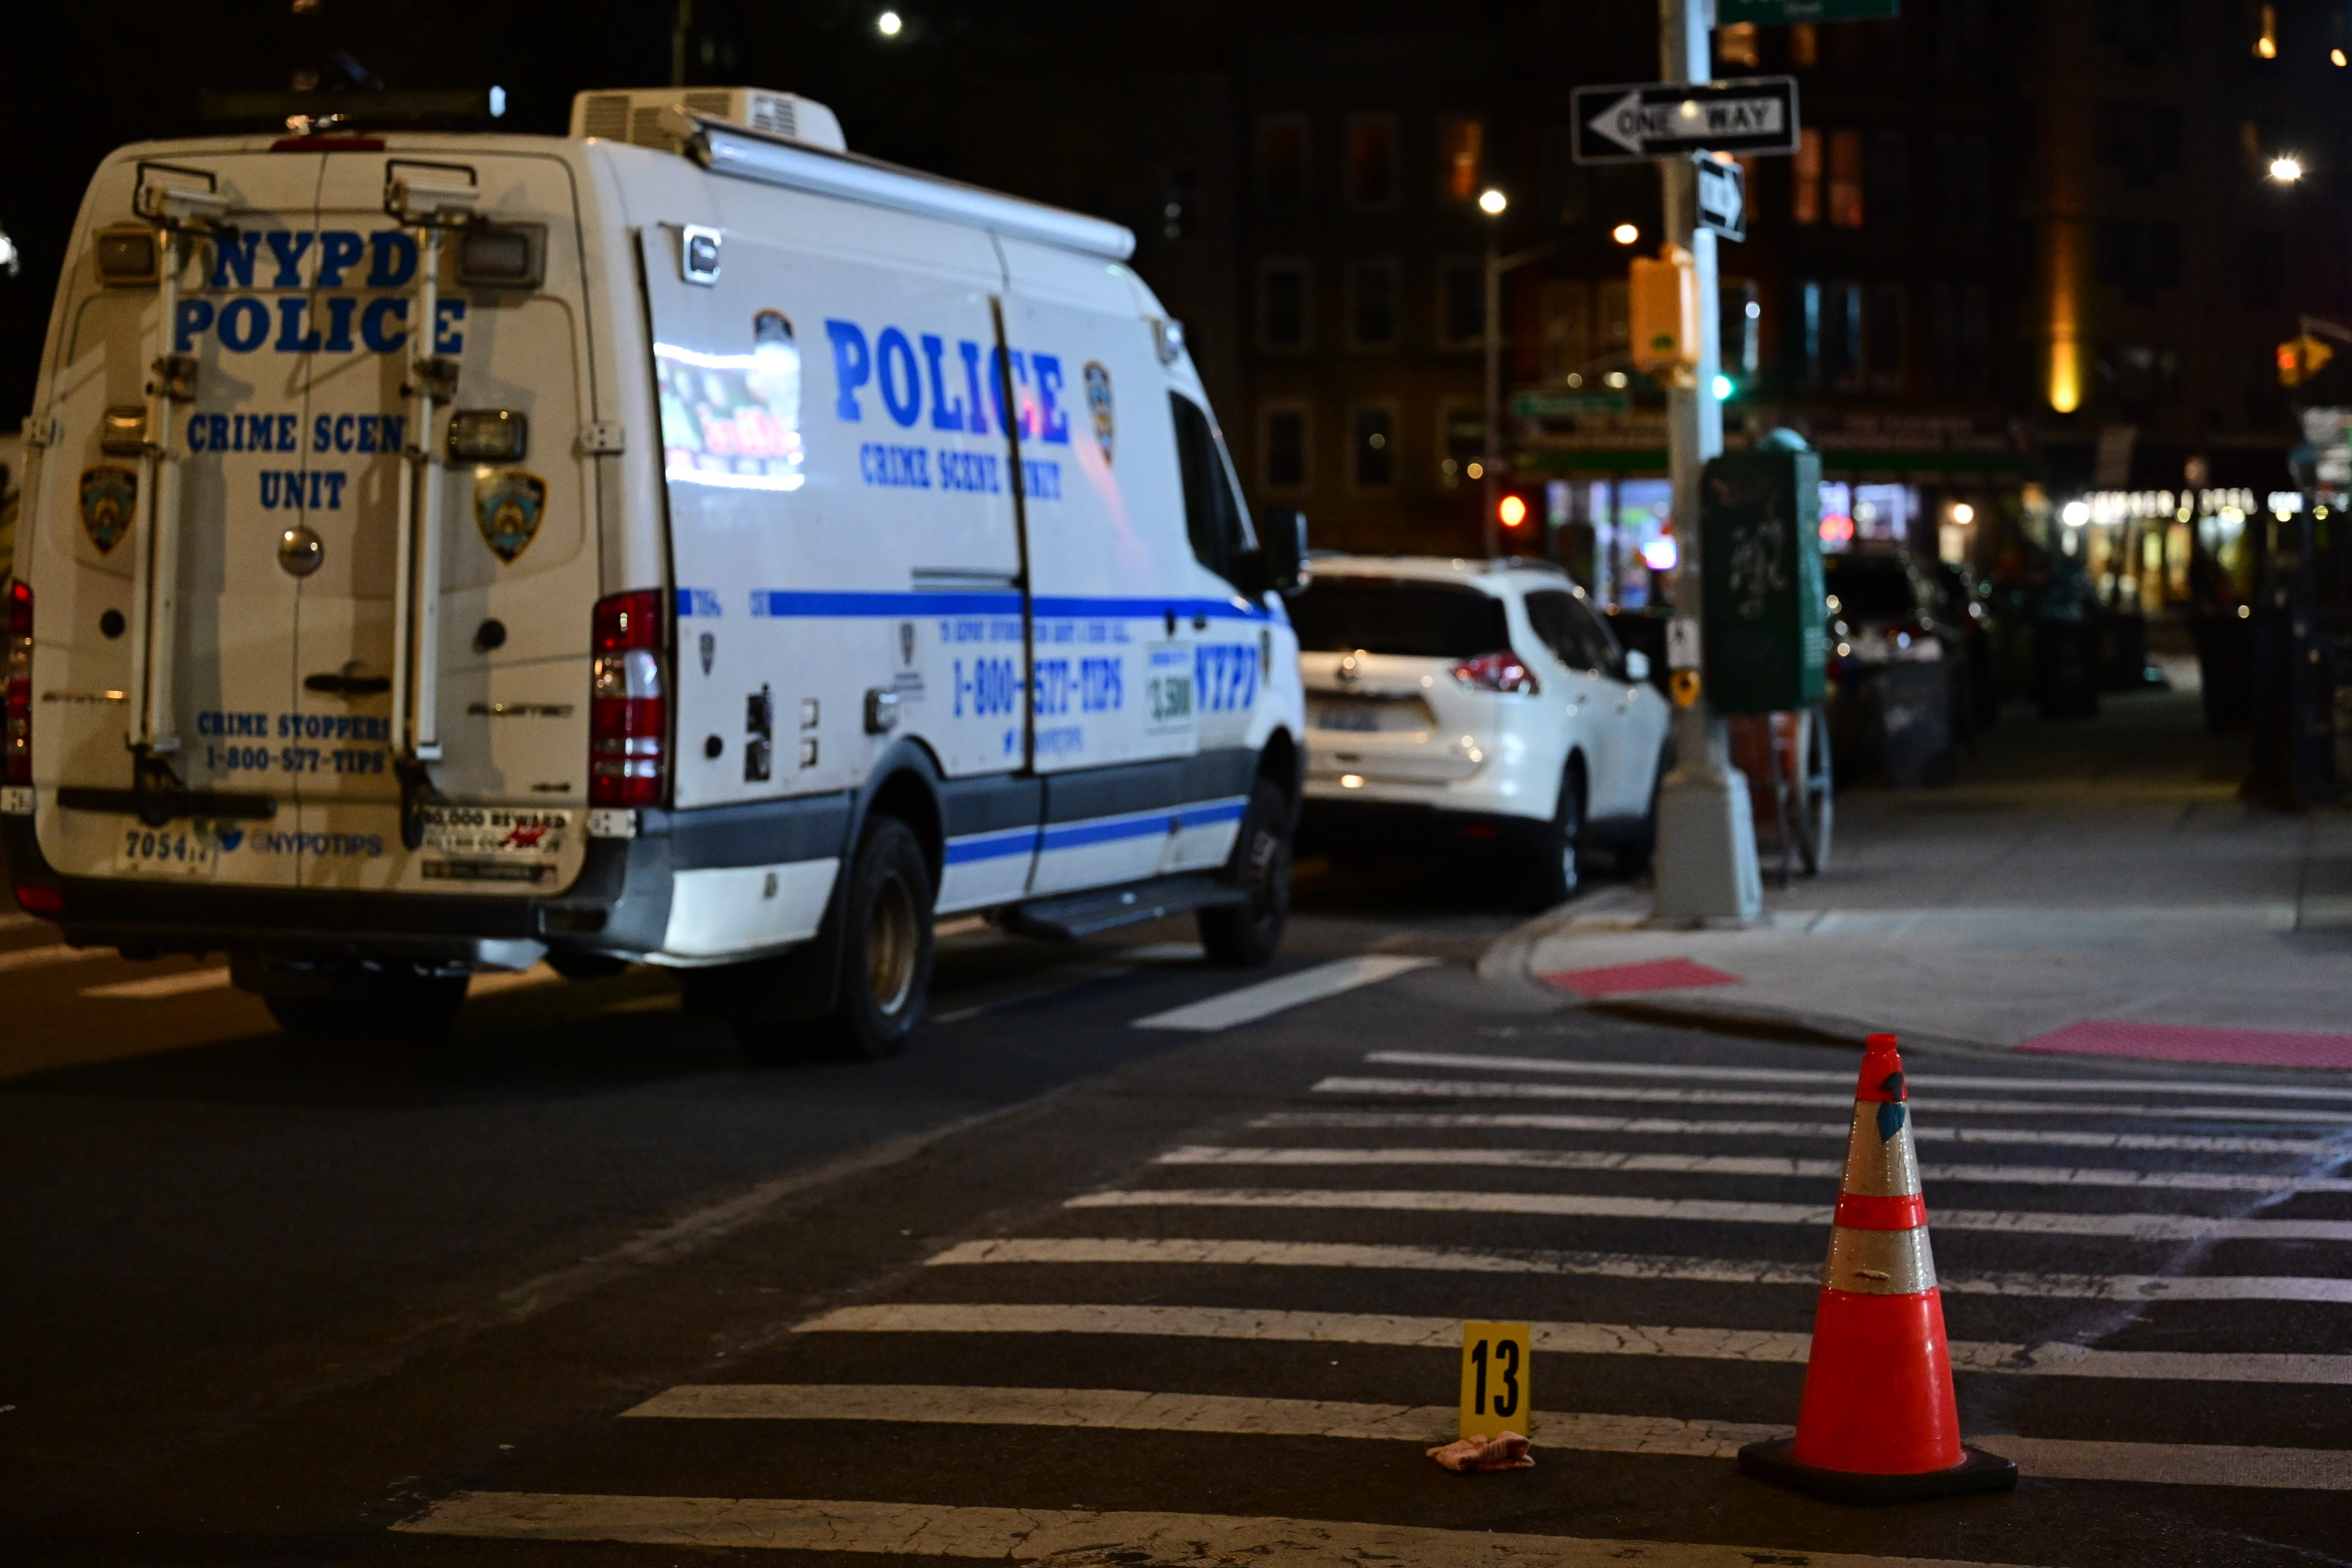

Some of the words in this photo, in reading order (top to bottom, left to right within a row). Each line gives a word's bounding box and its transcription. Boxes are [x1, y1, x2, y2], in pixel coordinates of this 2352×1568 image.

[1616, 108, 1669, 136] ONE
[1707, 102, 1770, 131] WAY
[213, 230, 418, 287] NYPD
[174, 295, 466, 354] POLICE
[824, 317, 1071, 446] POLICE
[187, 413, 298, 453] CRIME
[313, 413, 409, 454] SCEN
[859, 441, 931, 489] CRIME
[258, 470, 347, 510] UNIT
[197, 711, 269, 738] CRIME
[206, 743, 385, 775] 1-800-577-TIPS
[1471, 1339, 1519, 1418] 13
